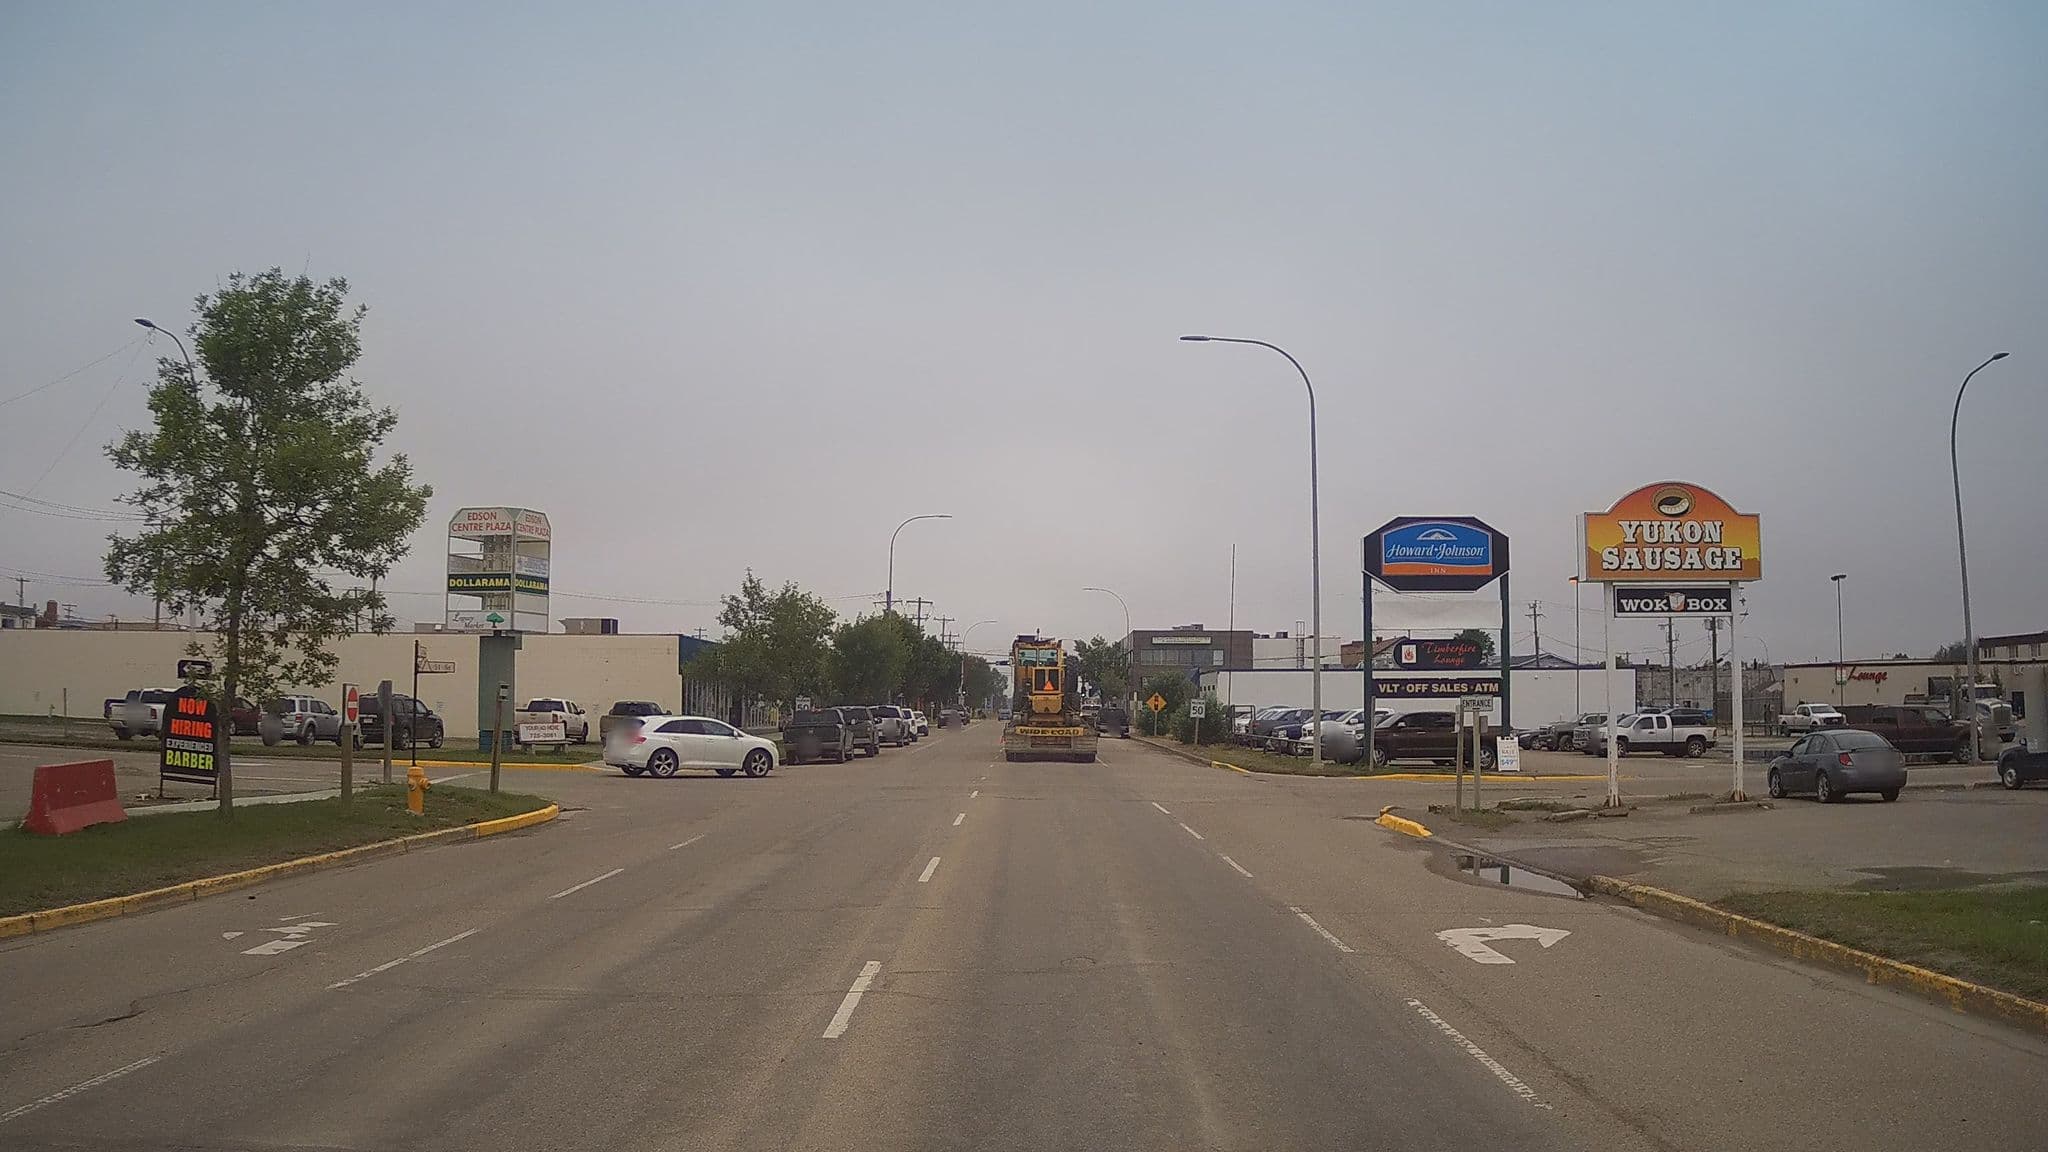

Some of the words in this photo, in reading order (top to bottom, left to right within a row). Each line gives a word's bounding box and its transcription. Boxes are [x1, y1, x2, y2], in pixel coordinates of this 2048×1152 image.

[467, 511, 497, 521] EDSON
[451, 523, 483, 532] CENTRE
[485, 522, 512, 531] PLAZA
[1618, 520, 1723, 544] YUKON
[1386, 543, 1435, 558] Howard
[1437, 543, 1484, 560] Johnson
[1602, 547, 1742, 571] SAUSAGE
[449, 578, 511, 587] DOLLARAMA
[515, 579, 548, 590] DOLLARAMA
[1620, 599, 1669, 611] WOK
[1687, 598, 1727, 611] BOX
[1848, 666, 1888, 684] Lounge
[1379, 683, 1400, 694] VLT
[1406, 683, 1428, 693] OFF
[1431, 683, 1468, 693] SALES
[1474, 683, 1499, 693] ATM
[178, 697, 207, 716] NOW
[1192, 705, 1203, 715] 50
[1462, 699, 1491, 708] ENTRANCE
[171, 719, 212, 738] HIRING
[166, 739, 214, 753] EXPERIENCED
[166, 750, 213, 770] BARBER
